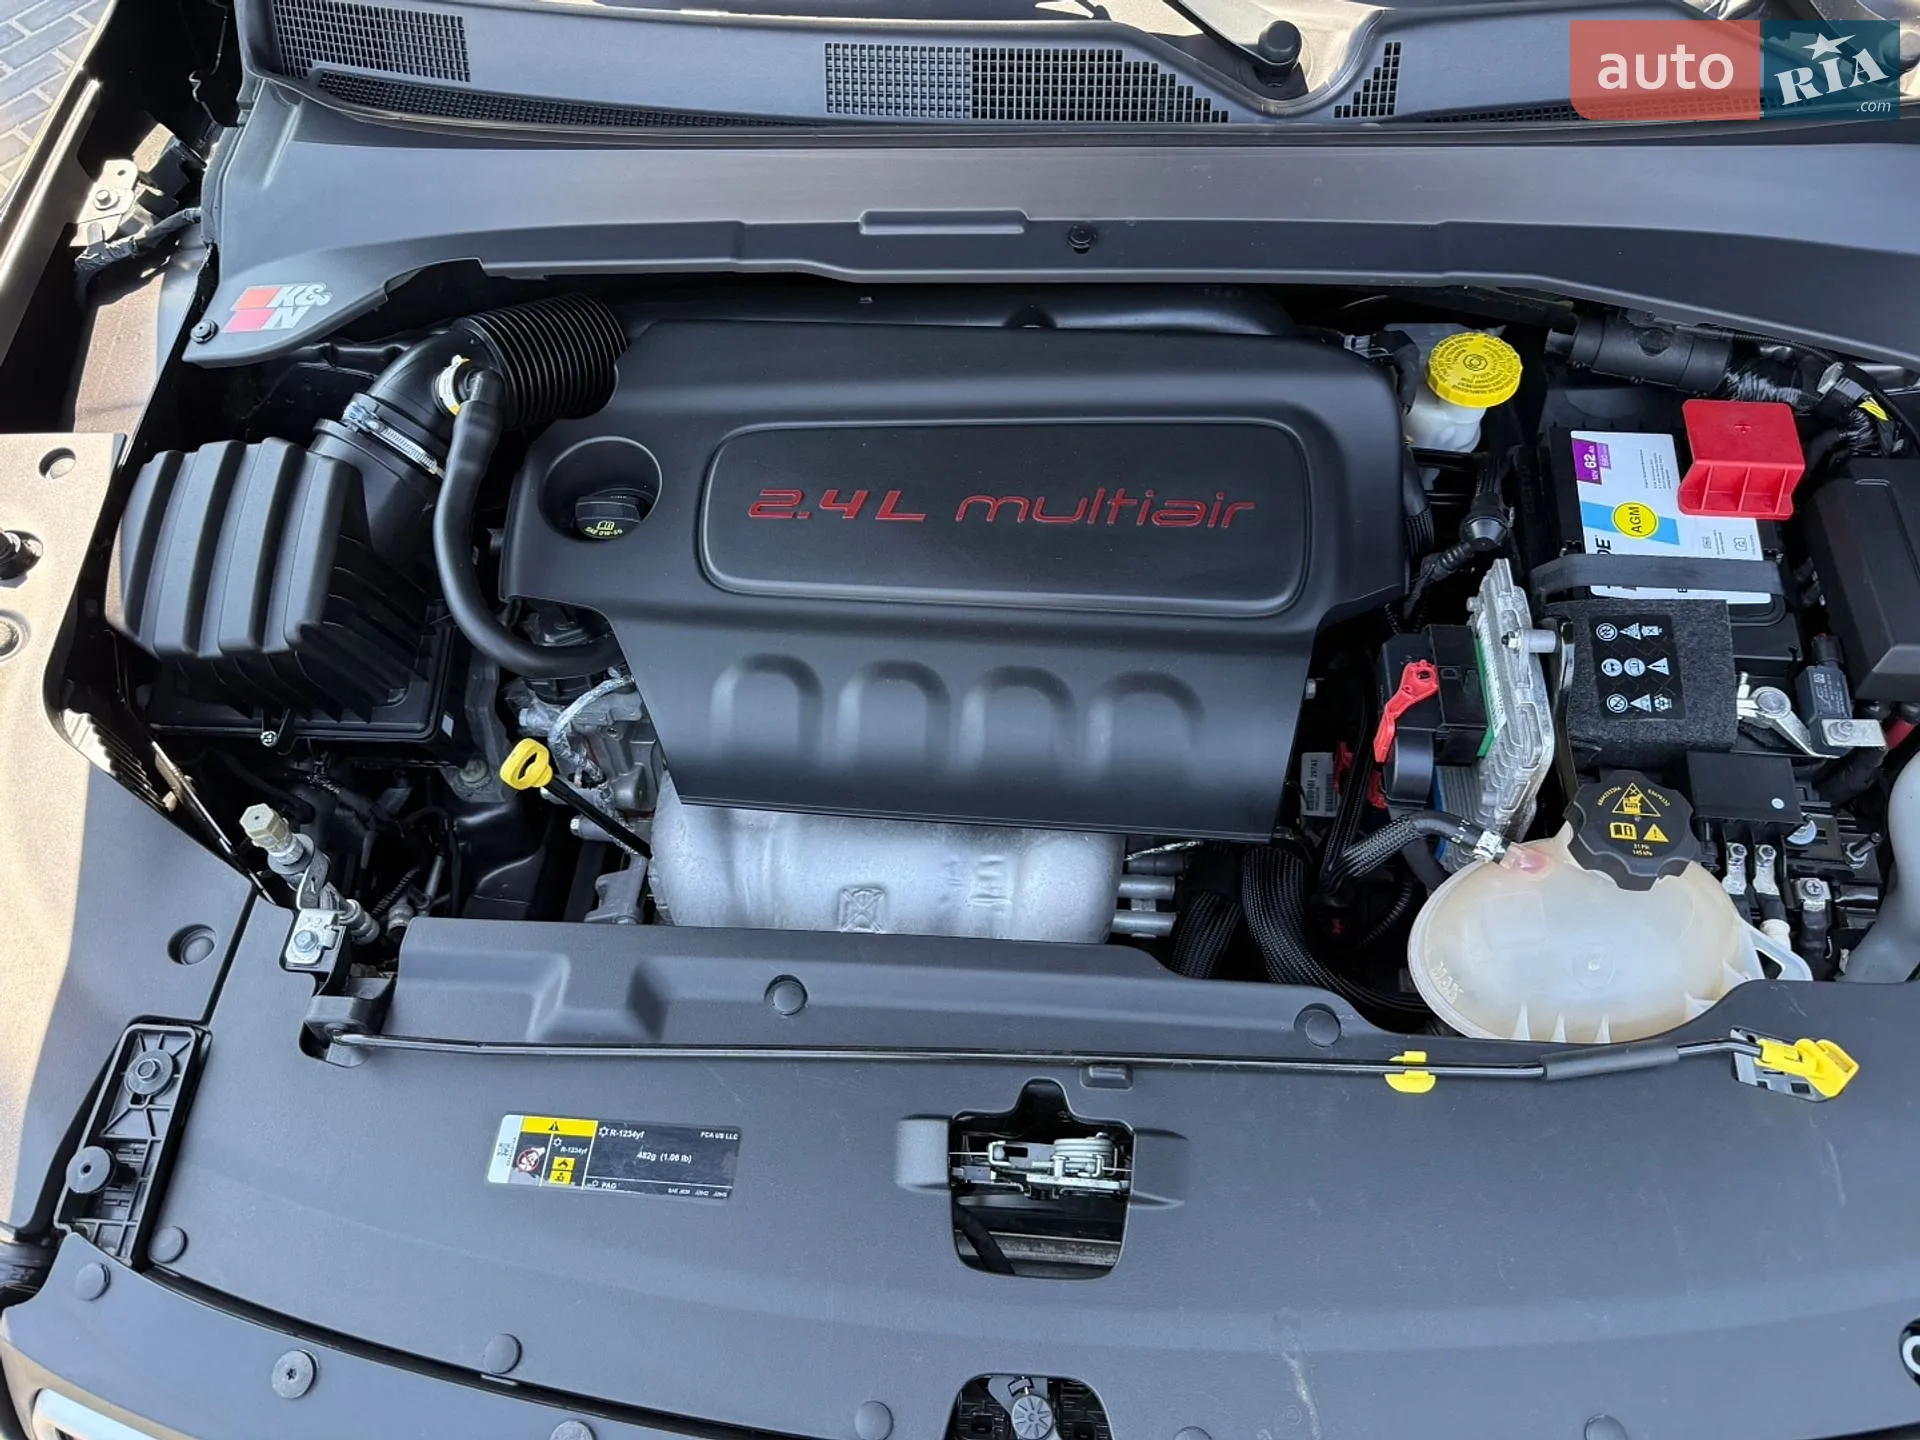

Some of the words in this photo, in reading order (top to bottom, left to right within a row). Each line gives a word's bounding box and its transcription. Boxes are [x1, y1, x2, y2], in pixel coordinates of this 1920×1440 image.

[1584, 454, 1597, 469] 62
[955, 487, 1255, 528] multiair
[1628, 506, 1643, 534] AGM
[609, 1129, 645, 1140] R-1234yf
[700, 1131, 714, 1139] FCA
[725, 1132, 739, 1140] LLC
